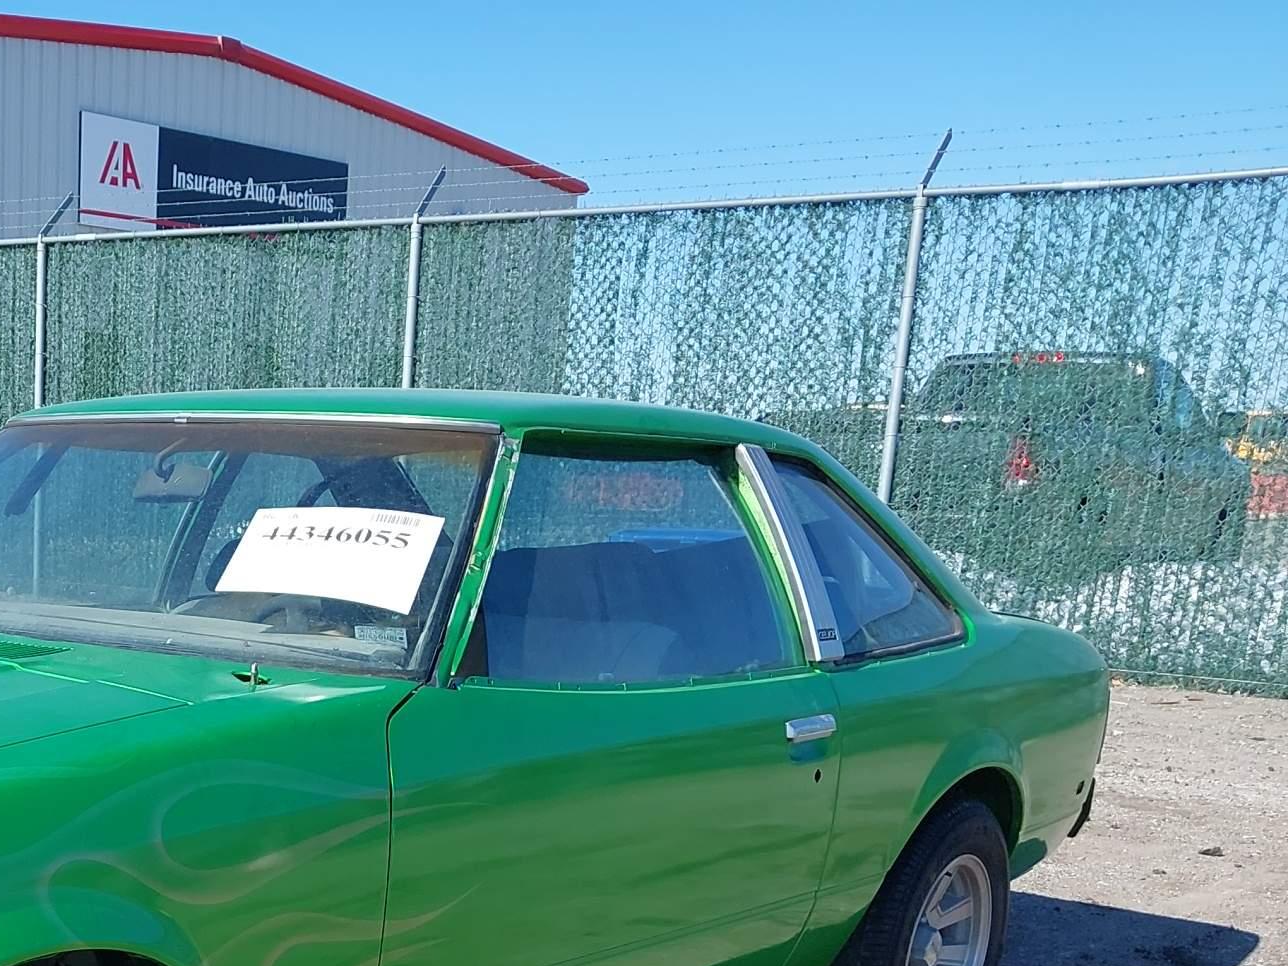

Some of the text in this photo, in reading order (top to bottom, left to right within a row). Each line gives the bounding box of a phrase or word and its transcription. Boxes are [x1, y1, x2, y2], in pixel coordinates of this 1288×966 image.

[171, 163, 334, 214] Insurance Auto Auctions
[262, 526, 411, 549] 44346055
